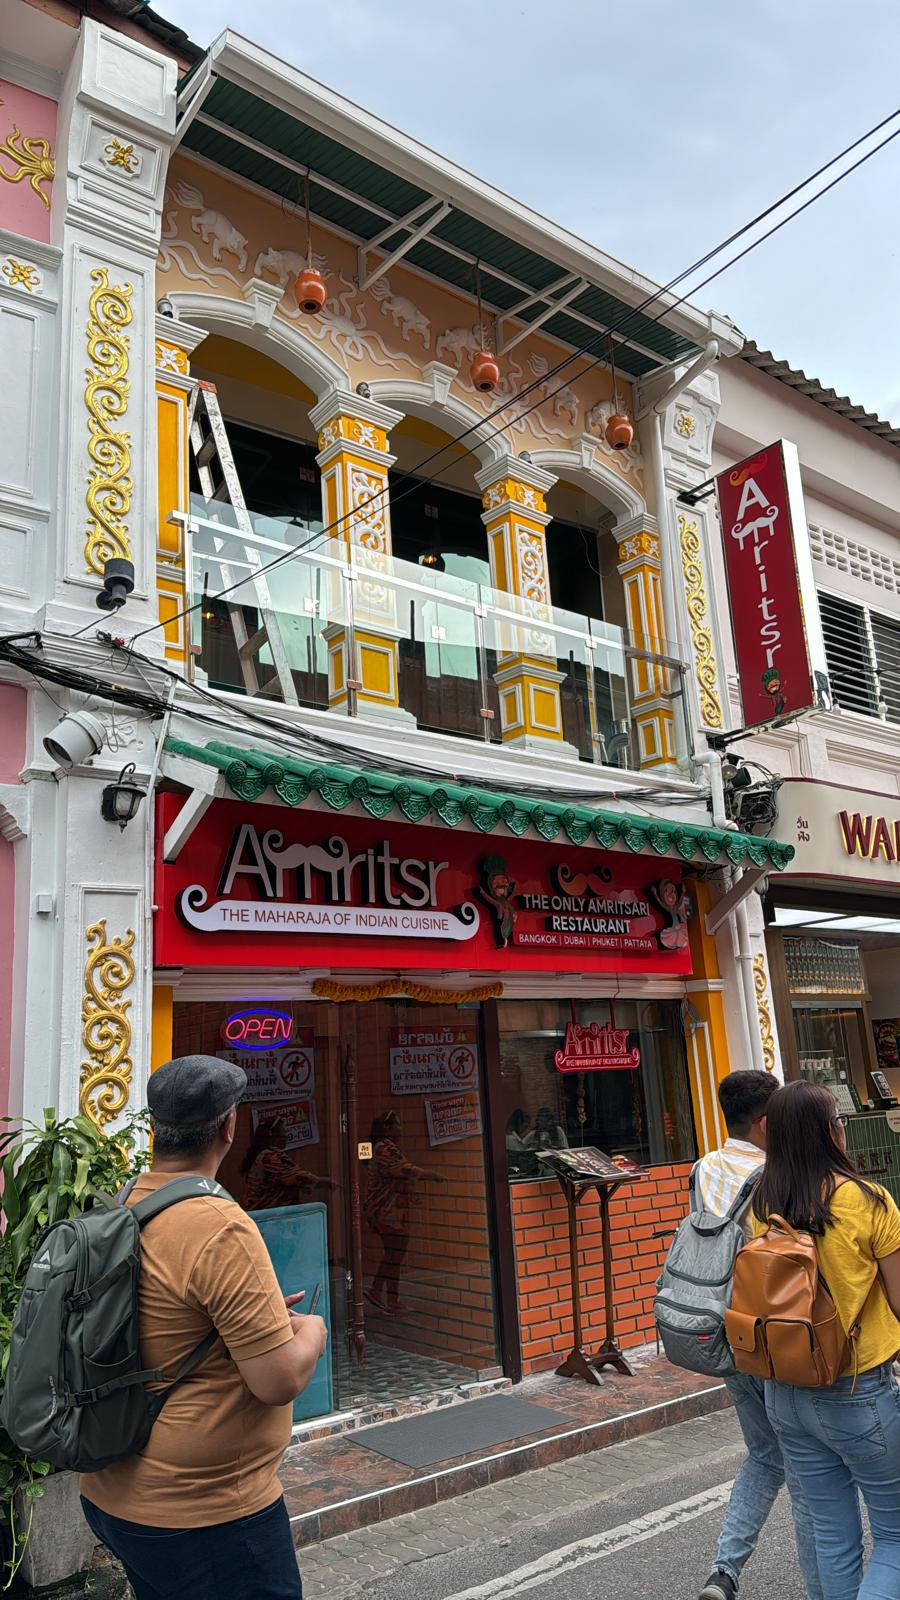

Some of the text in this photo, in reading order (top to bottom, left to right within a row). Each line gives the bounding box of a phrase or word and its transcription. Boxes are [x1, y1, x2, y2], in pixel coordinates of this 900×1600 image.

[731, 478, 781, 669] Amritsr
[222, 823, 450, 907] Amritsr
[523, 893, 650, 916] THE ONLY AMRITSARI
[220, 908, 449, 931] THE MAHARAJA OF INDIAN CUISINE
[552, 915, 631, 934] RESTAURANT
[519, 933, 652, 949] BANGKOK DUBAI PHUKET PATTAYA
[225, 1018, 293, 1041] OPEN
